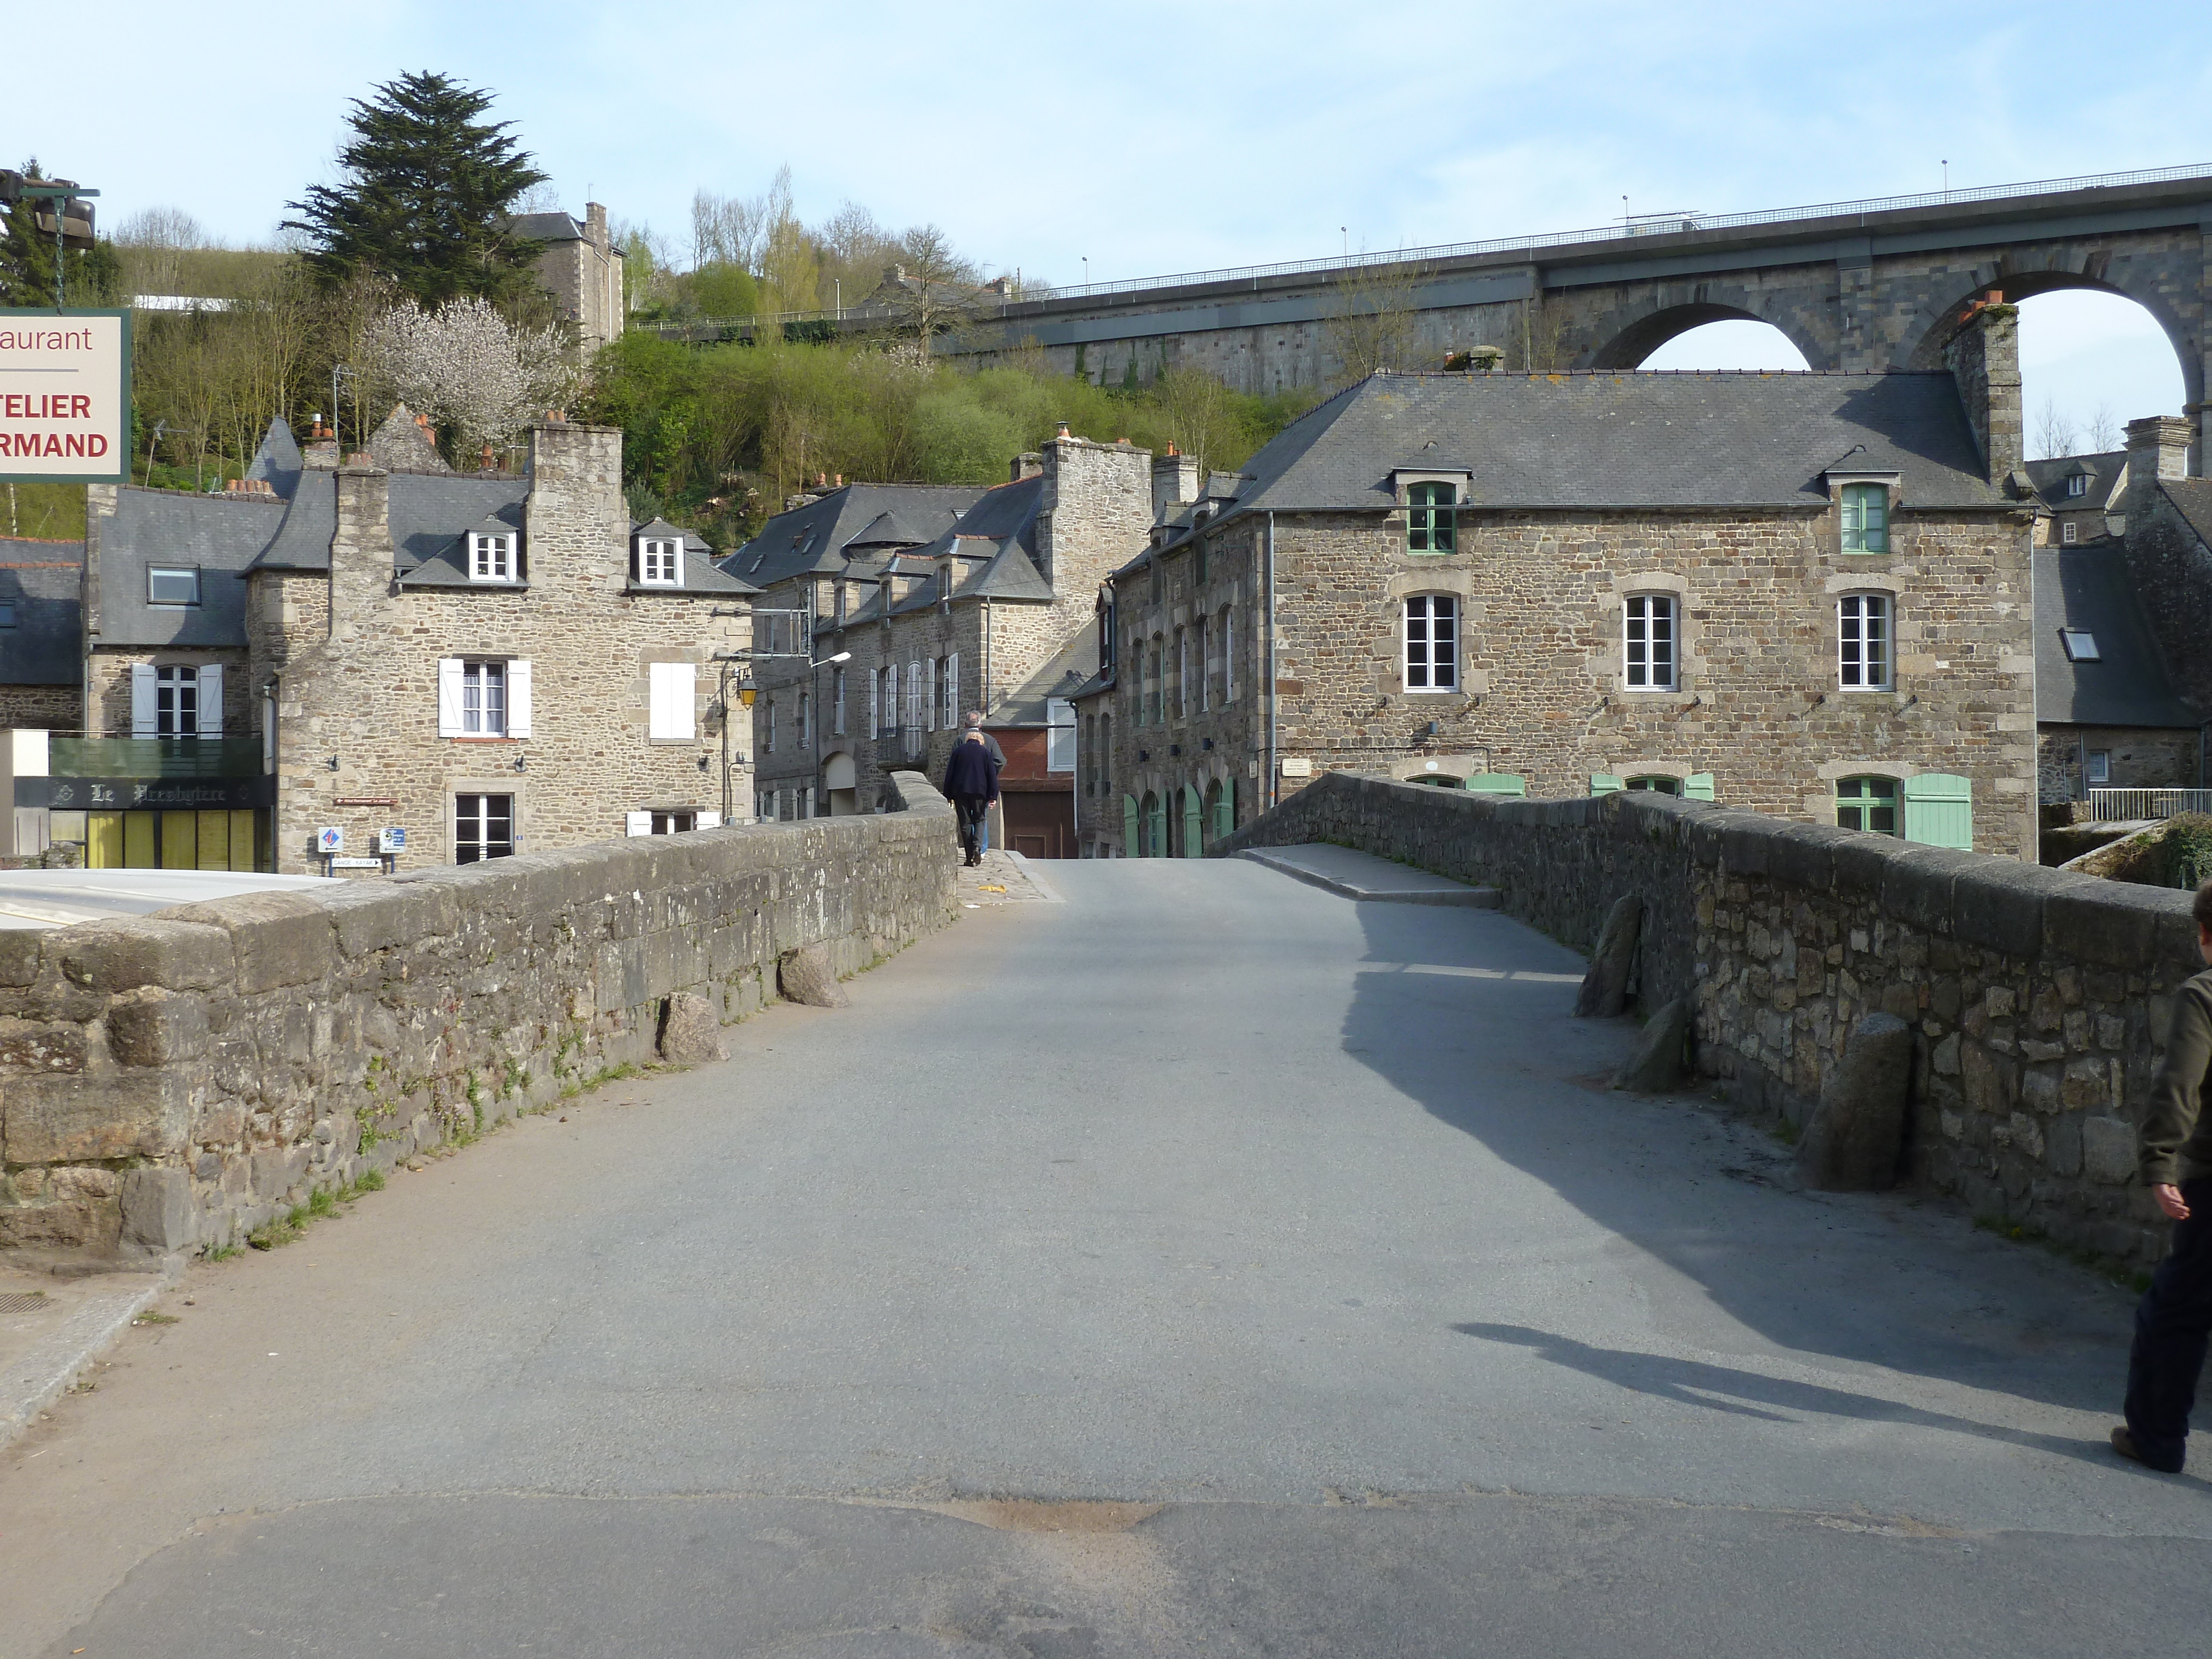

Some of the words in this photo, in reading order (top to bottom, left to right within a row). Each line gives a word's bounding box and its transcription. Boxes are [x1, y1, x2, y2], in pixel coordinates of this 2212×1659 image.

[0, 328, 93, 350] aurant
[0, 394, 91, 419] ELIER
[91, 784, 114, 802] Le
